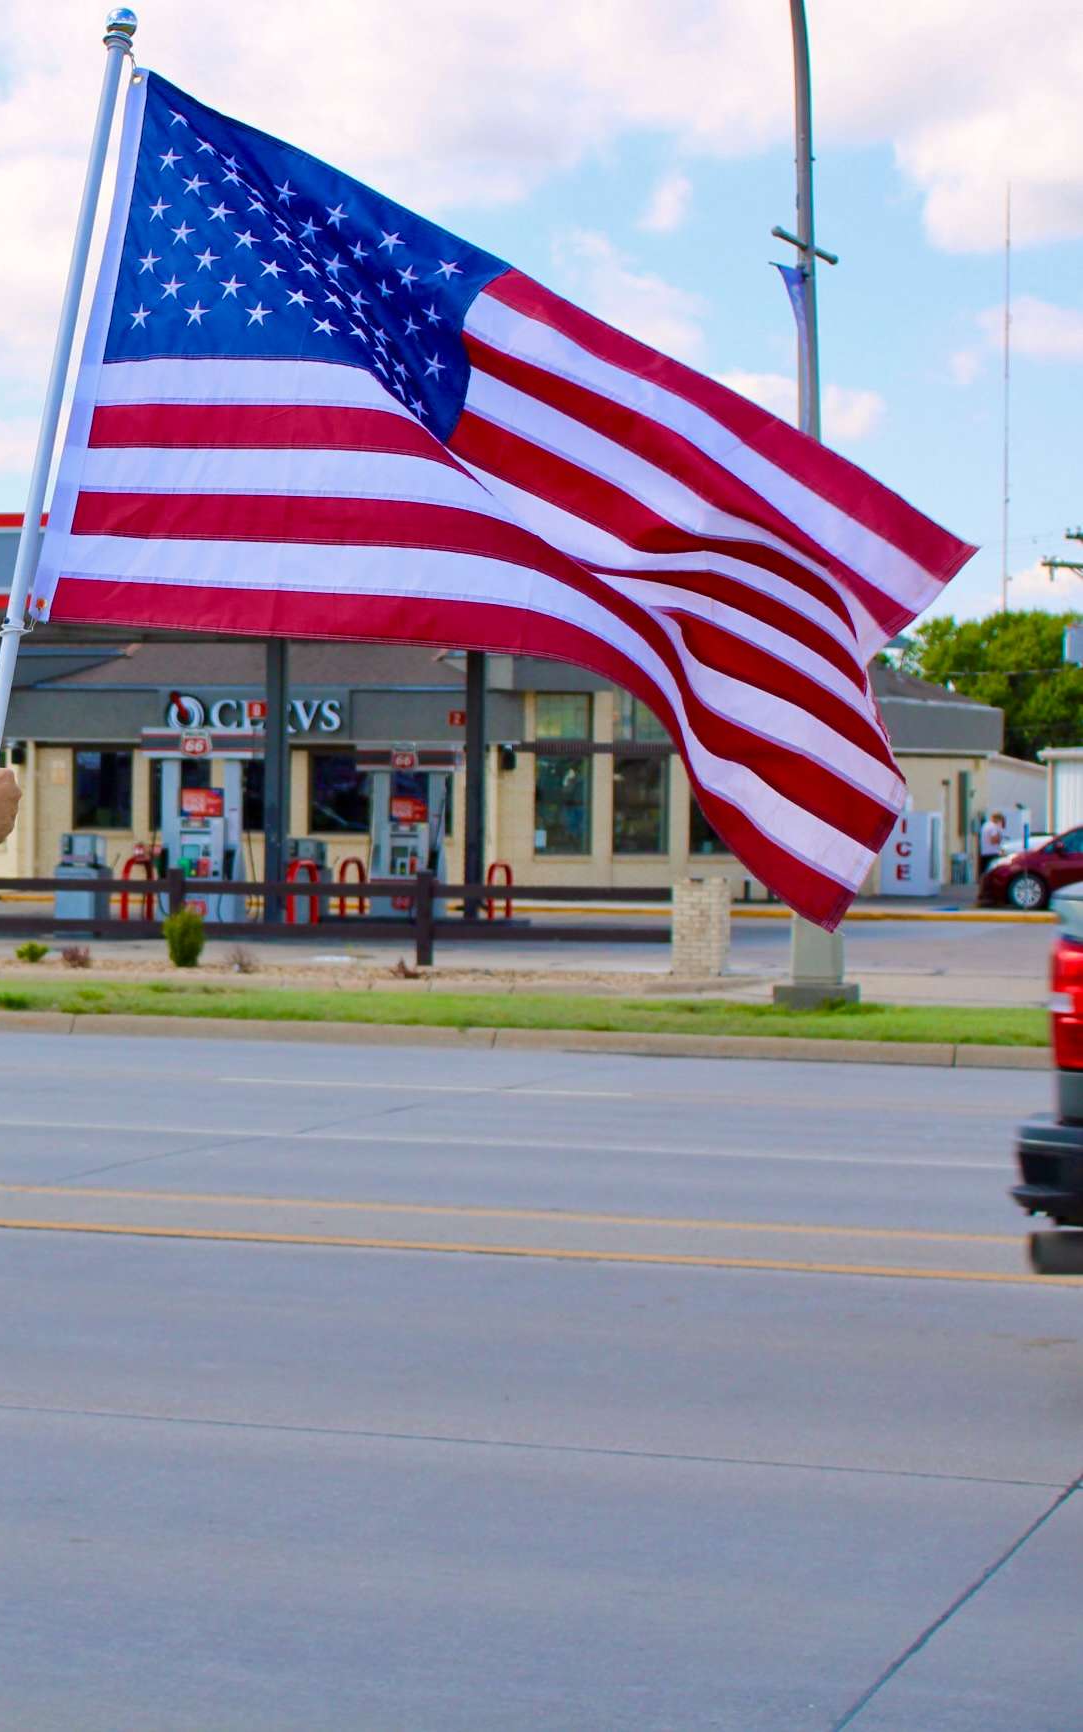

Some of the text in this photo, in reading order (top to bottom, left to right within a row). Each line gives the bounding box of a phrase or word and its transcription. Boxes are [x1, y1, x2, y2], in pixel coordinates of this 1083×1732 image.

[185, 741, 205, 752] 66
[394, 753, 412, 765] 66
[896, 818, 912, 881] ICE
